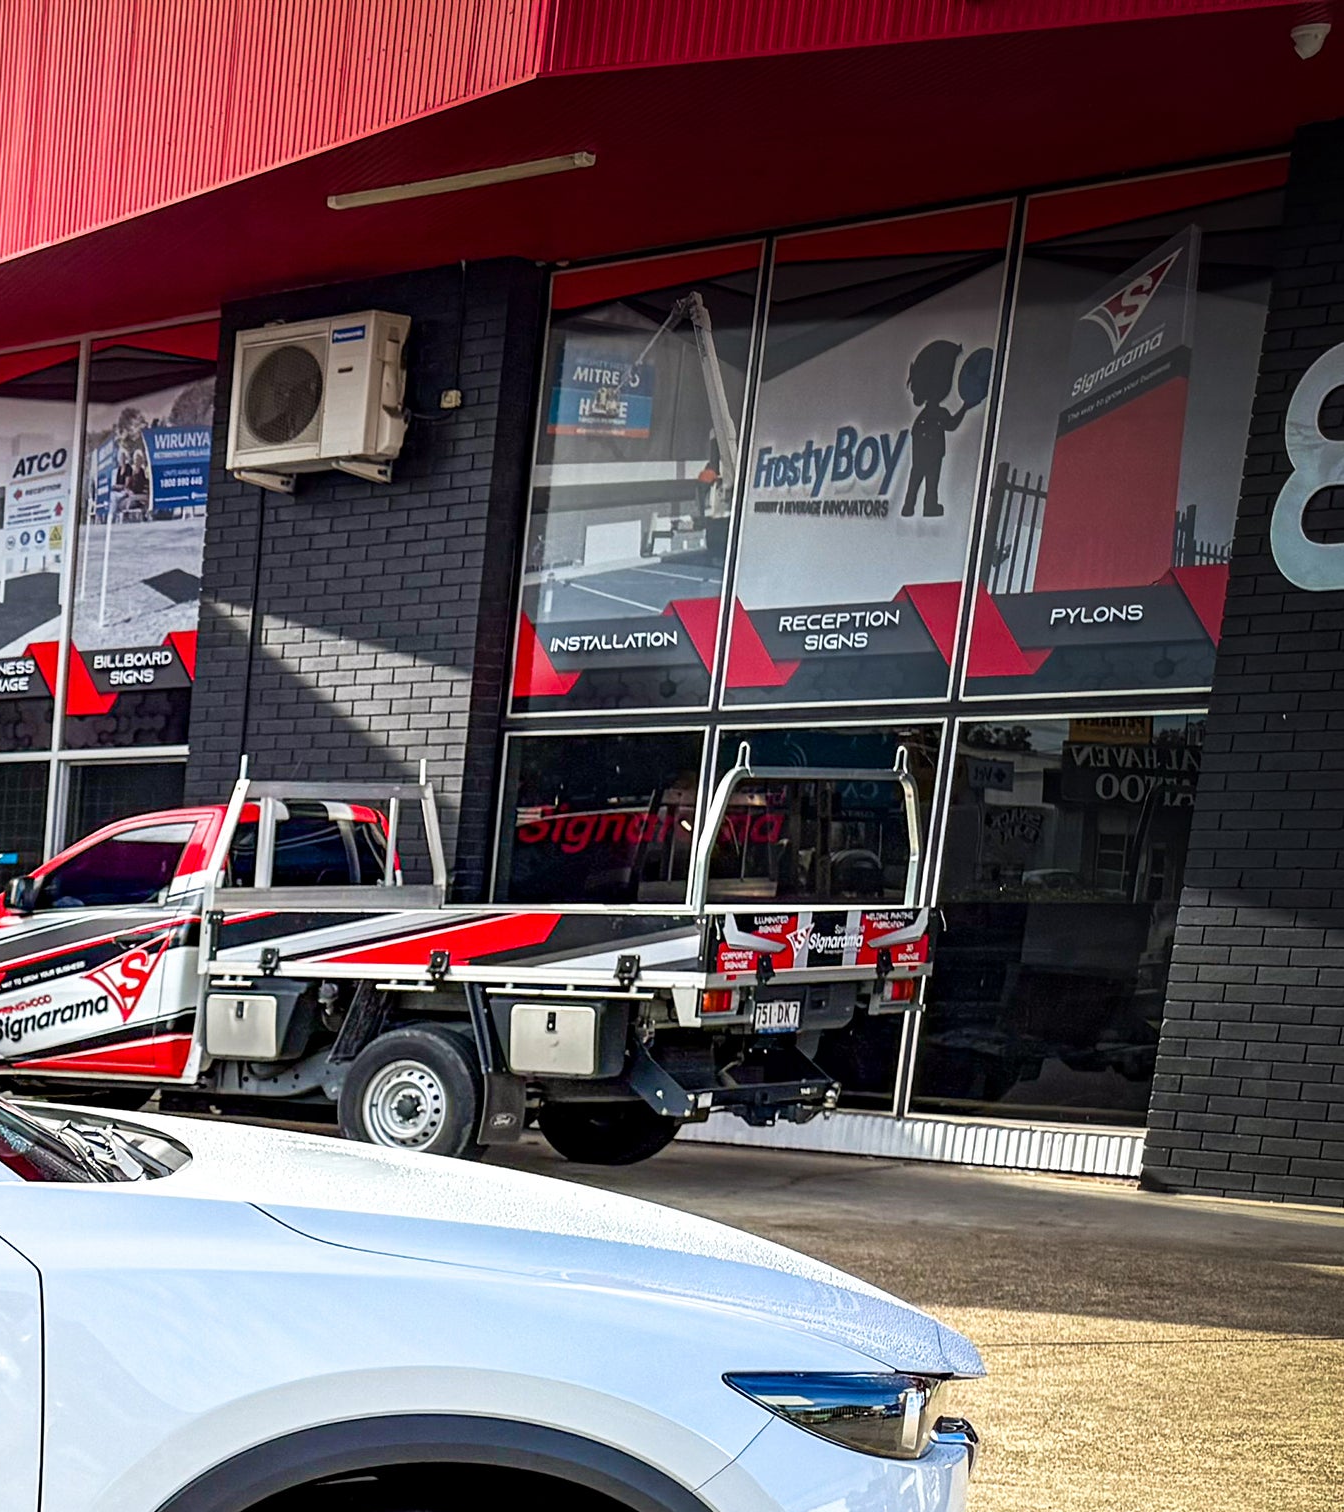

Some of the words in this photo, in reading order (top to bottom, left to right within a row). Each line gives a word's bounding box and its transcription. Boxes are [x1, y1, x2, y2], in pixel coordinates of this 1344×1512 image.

[1071, 331, 1163, 397] Signarama
[573, 366, 620, 385] MITRE
[579, 398, 628, 418] HE
[154, 432, 211, 450] WIRUNYA
[12, 448, 67, 479] ATCO
[822, 500, 890, 519] INNOVATORS
[778, 610, 900, 632] RECEPTION
[1049, 603, 1144, 626] PYLONS
[550, 630, 678, 653] INSTALLATION
[804, 632, 869, 650] SIGNS
[93, 650, 173, 670] BILLBOARD
[109, 668, 155, 685] SIGNS
[808, 932, 864, 955] Signarama
